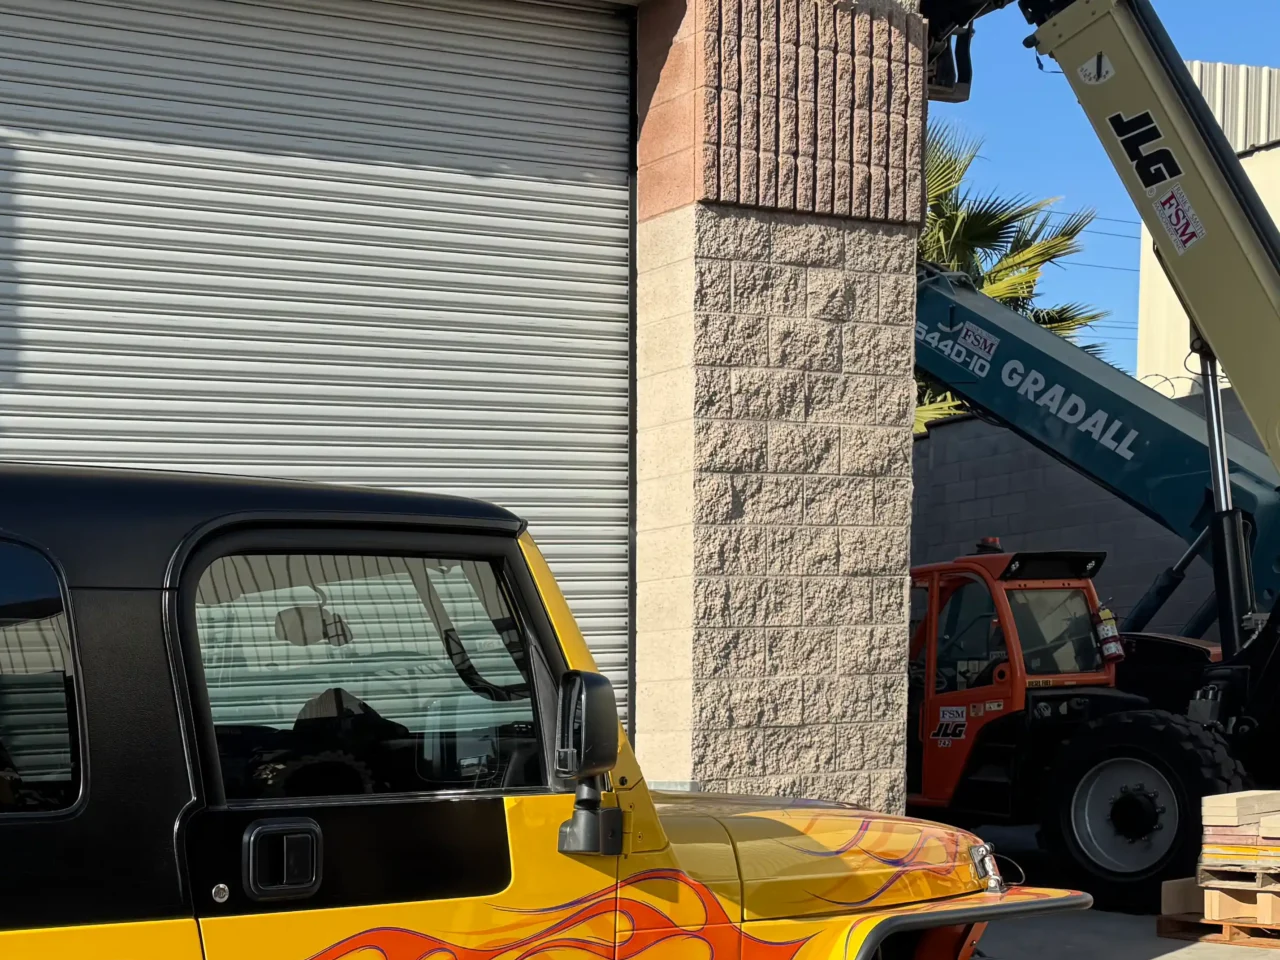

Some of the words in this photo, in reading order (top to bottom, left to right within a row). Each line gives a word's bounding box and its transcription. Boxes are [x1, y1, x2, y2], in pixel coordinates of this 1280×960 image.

[1107, 110, 1184, 190] JLG
[1159, 190, 1198, 248] FSM
[960, 327, 996, 356] FSM
[1001, 359, 1139, 461] GRADALL
[930, 721, 967, 739] JLG
[941, 709, 965, 719] FSM
